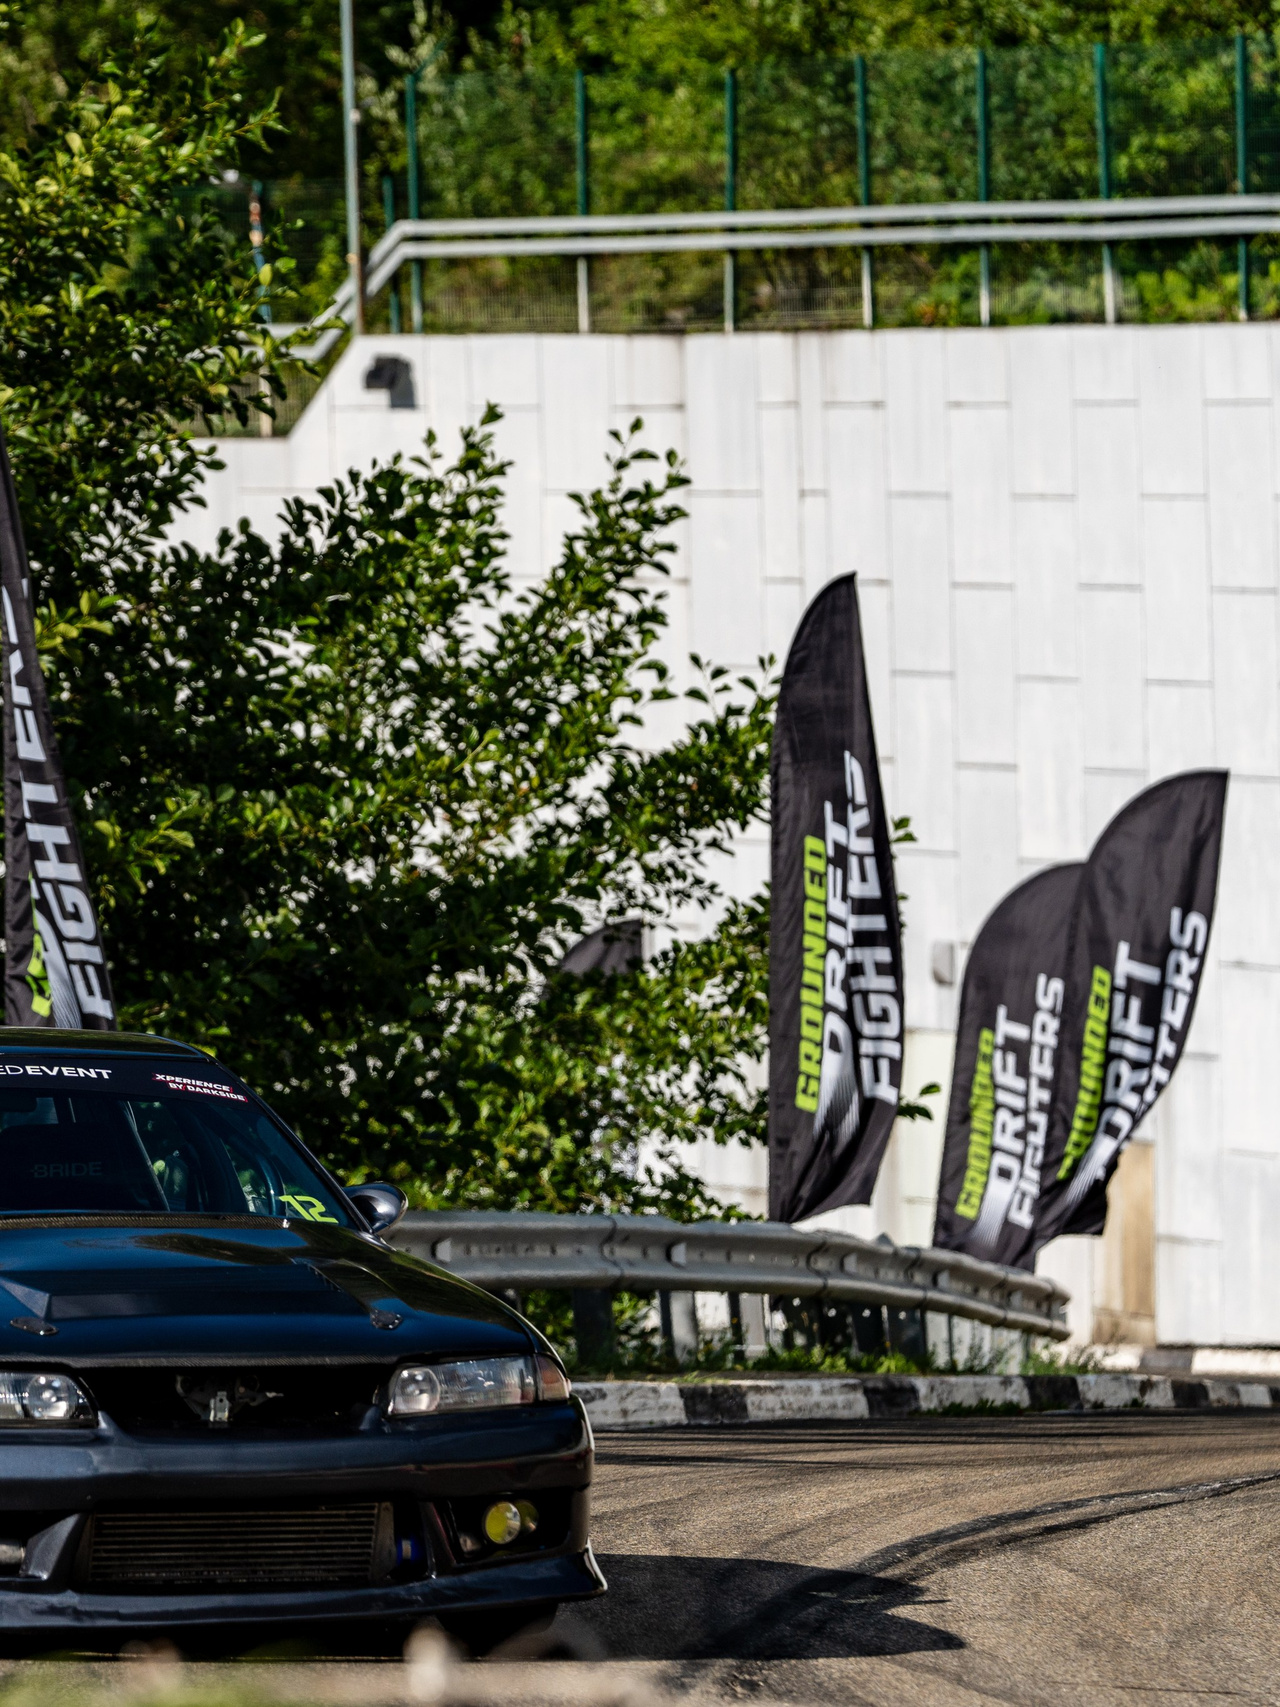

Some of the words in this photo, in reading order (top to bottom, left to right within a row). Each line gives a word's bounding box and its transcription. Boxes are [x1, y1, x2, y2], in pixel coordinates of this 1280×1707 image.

[795, 835, 829, 1113] GROUNDED
[818, 800, 857, 1112] DRIFT
[1088, 940, 1162, 1170] DRIFT
[33, 1161, 103, 1179] BRIDE
[154, 1073, 231, 1092] XPERIENCE
[168, 1082, 184, 1090] BY
[186, 1085, 246, 1102] DARKSIDE
[981, 1004, 1031, 1214] DRIFT
